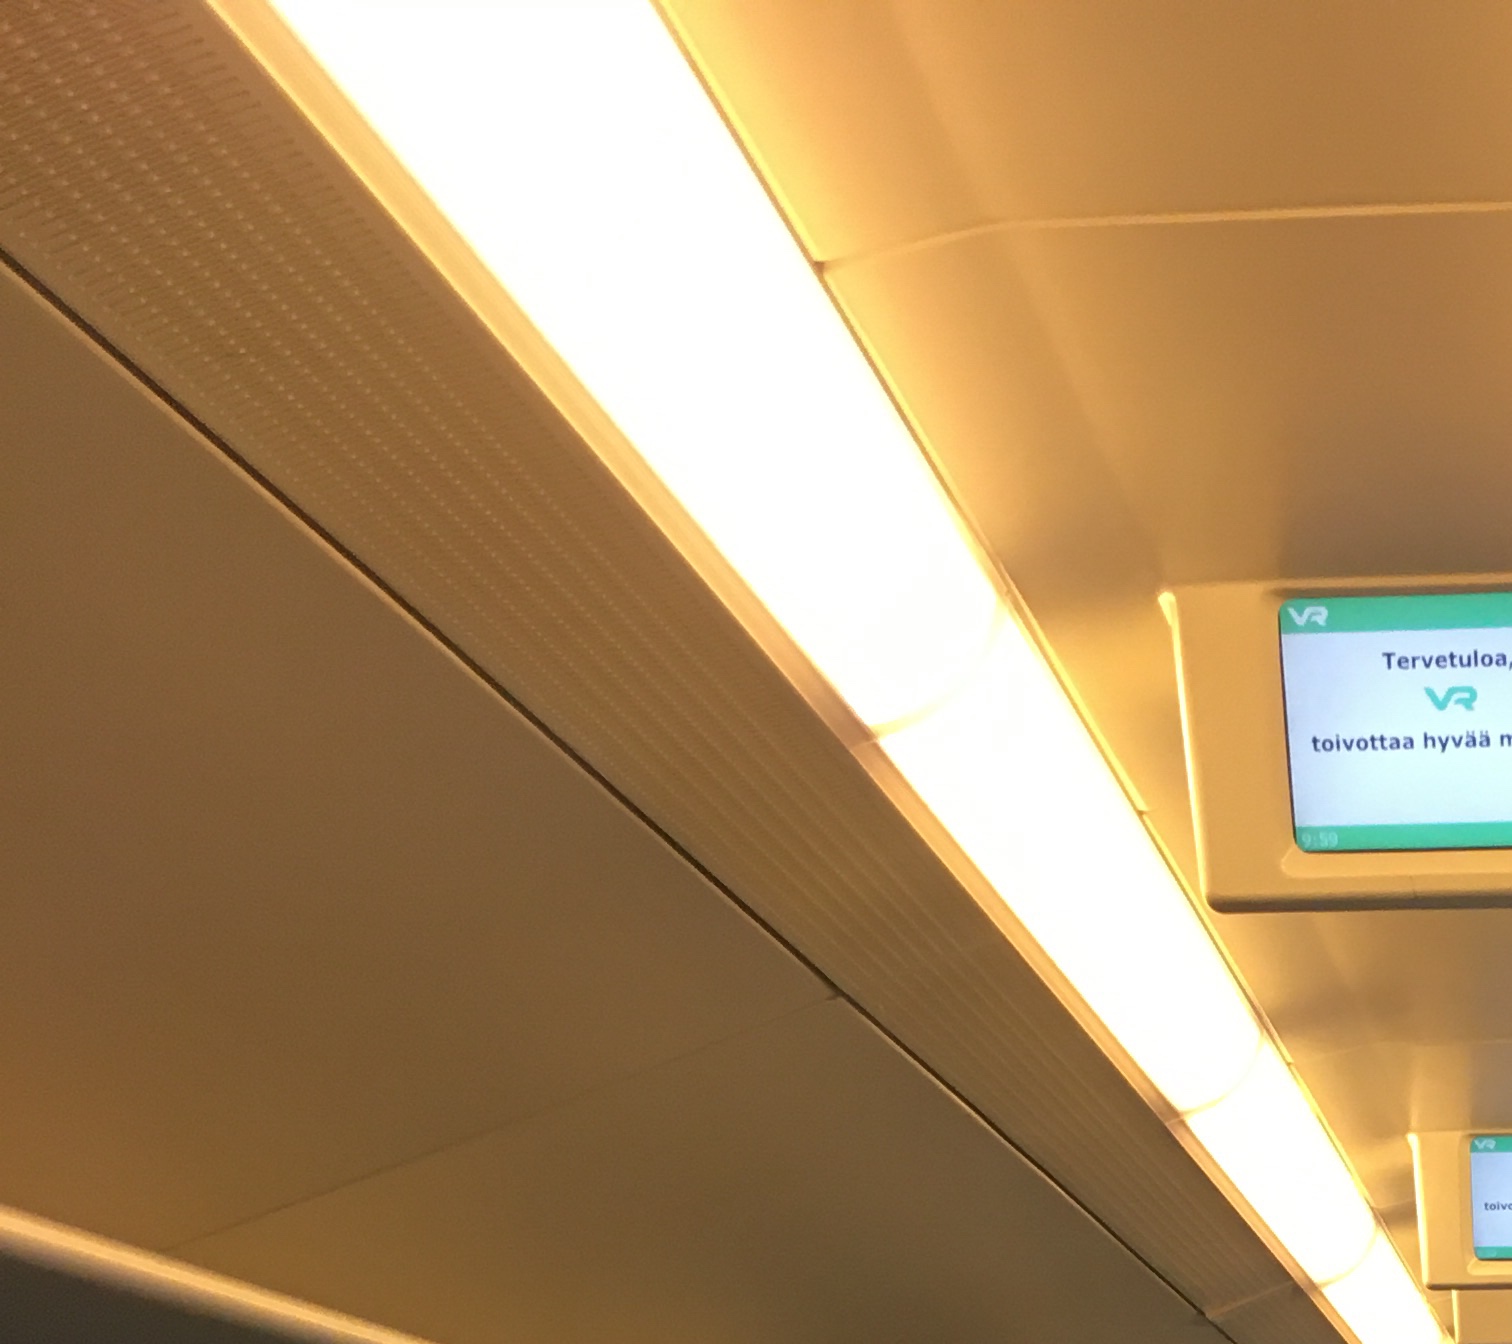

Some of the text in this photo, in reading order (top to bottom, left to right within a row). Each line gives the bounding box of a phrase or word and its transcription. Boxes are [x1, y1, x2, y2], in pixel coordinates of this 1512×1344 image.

[1287, 606, 1328, 626] VR
[1424, 685, 1478, 711] VR
[1311, 734, 1415, 752] toivottaa
[1423, 731, 1491, 753] hyvää
